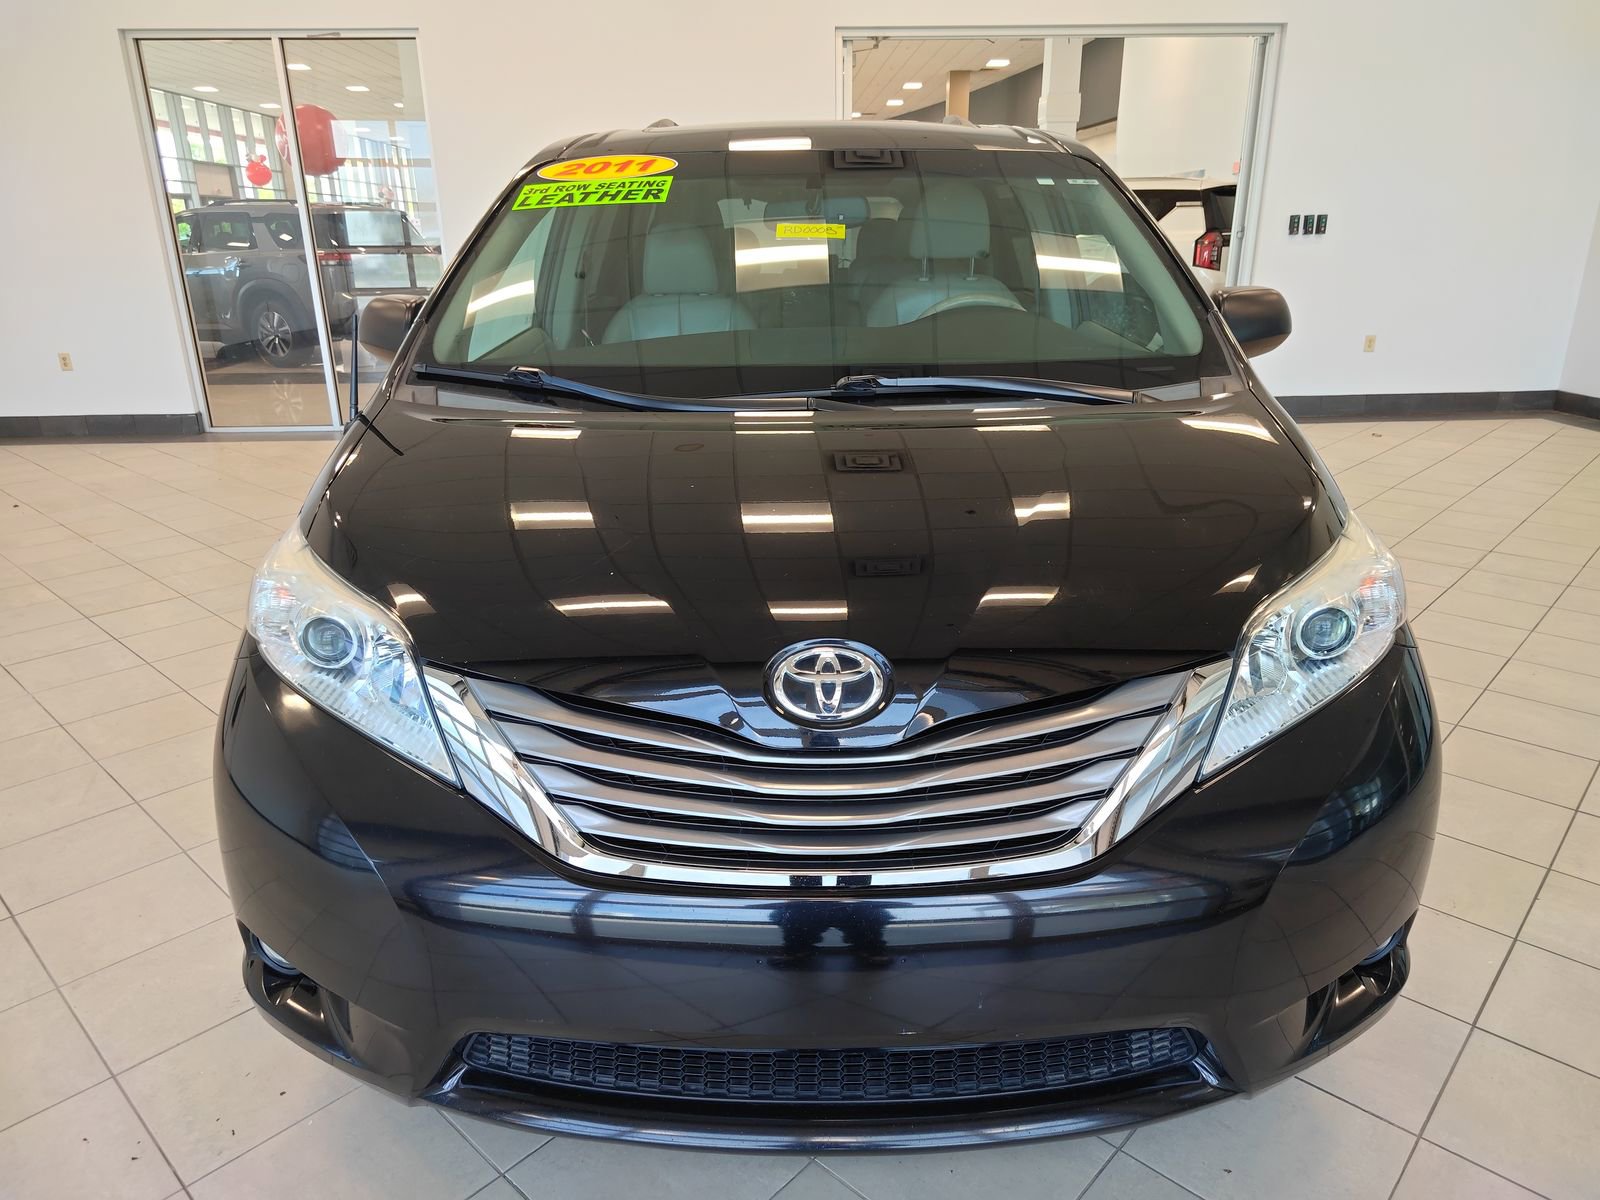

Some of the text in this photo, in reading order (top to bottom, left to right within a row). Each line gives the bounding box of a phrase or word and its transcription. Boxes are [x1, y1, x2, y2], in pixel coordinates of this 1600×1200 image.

[553, 159, 657, 176] 2011
[523, 180, 668, 196] 3rd ROW SEATING
[517, 188, 665, 208] LEATHER
